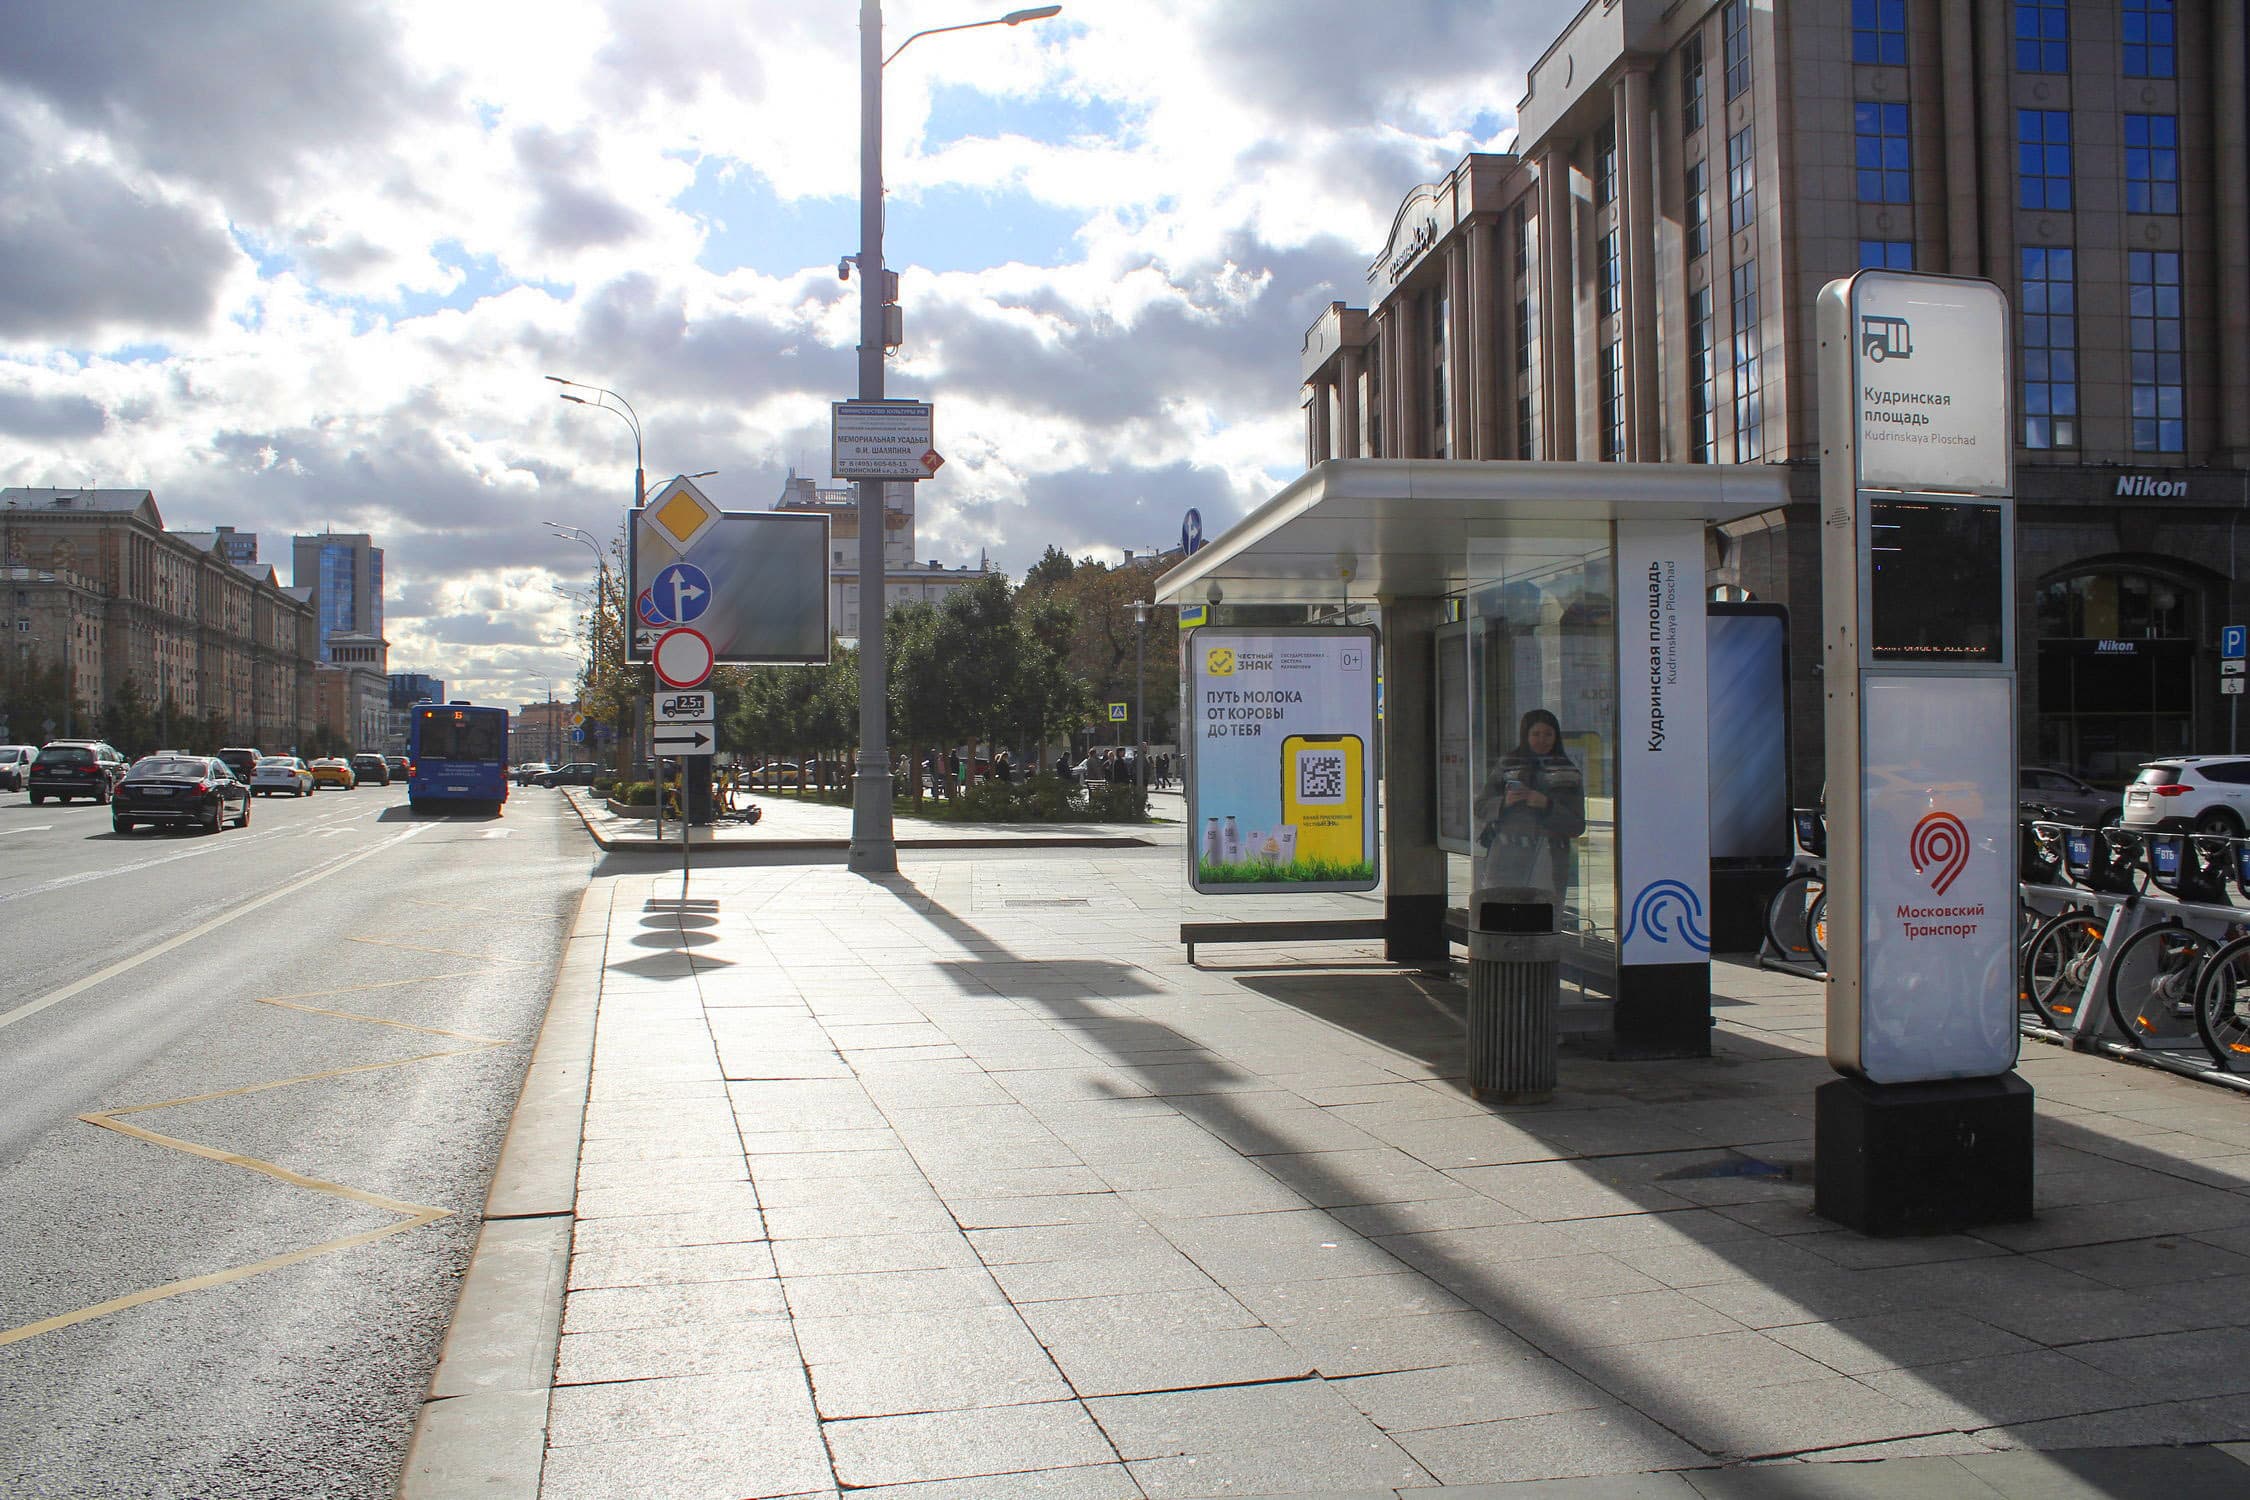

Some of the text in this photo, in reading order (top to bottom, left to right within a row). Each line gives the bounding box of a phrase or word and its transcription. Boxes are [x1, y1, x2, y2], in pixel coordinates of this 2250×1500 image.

[1864, 386, 1951, 405] Кудринская
[1864, 410, 1930, 426] площадь
[838, 435, 929, 444] МЕМОРИАЛЬНАЯ УСАДЬБА
[1864, 430, 1977, 446] Kudrinskaya Ploschad
[871, 447, 912, 455] ШАЛЯПИНА
[2115, 475, 2188, 497] Nikon
[1665, 561, 1677, 685] Kudrinskaya Ploschad
[2098, 639, 2134, 651] Nikon
[2227, 630, 2241, 654] P
[1343, 653, 1360, 666] 0+
[1648, 561, 1665, 752] Кудринская площадь
[1237, 661, 1273, 671] ЗНАК
[1207, 691, 1303, 704] ПУТЬ МОЛОКА
[1207, 708, 1284, 720] ОТ КОРОВЫ
[1207, 724, 1261, 738] ДО ТЕБЯ
[2074, 843, 2087, 853] ВТБ
[2160, 849, 2175, 860] ВТБ
[1897, 904, 1985, 919] Московский
[1903, 922, 1978, 941] Транспорт
